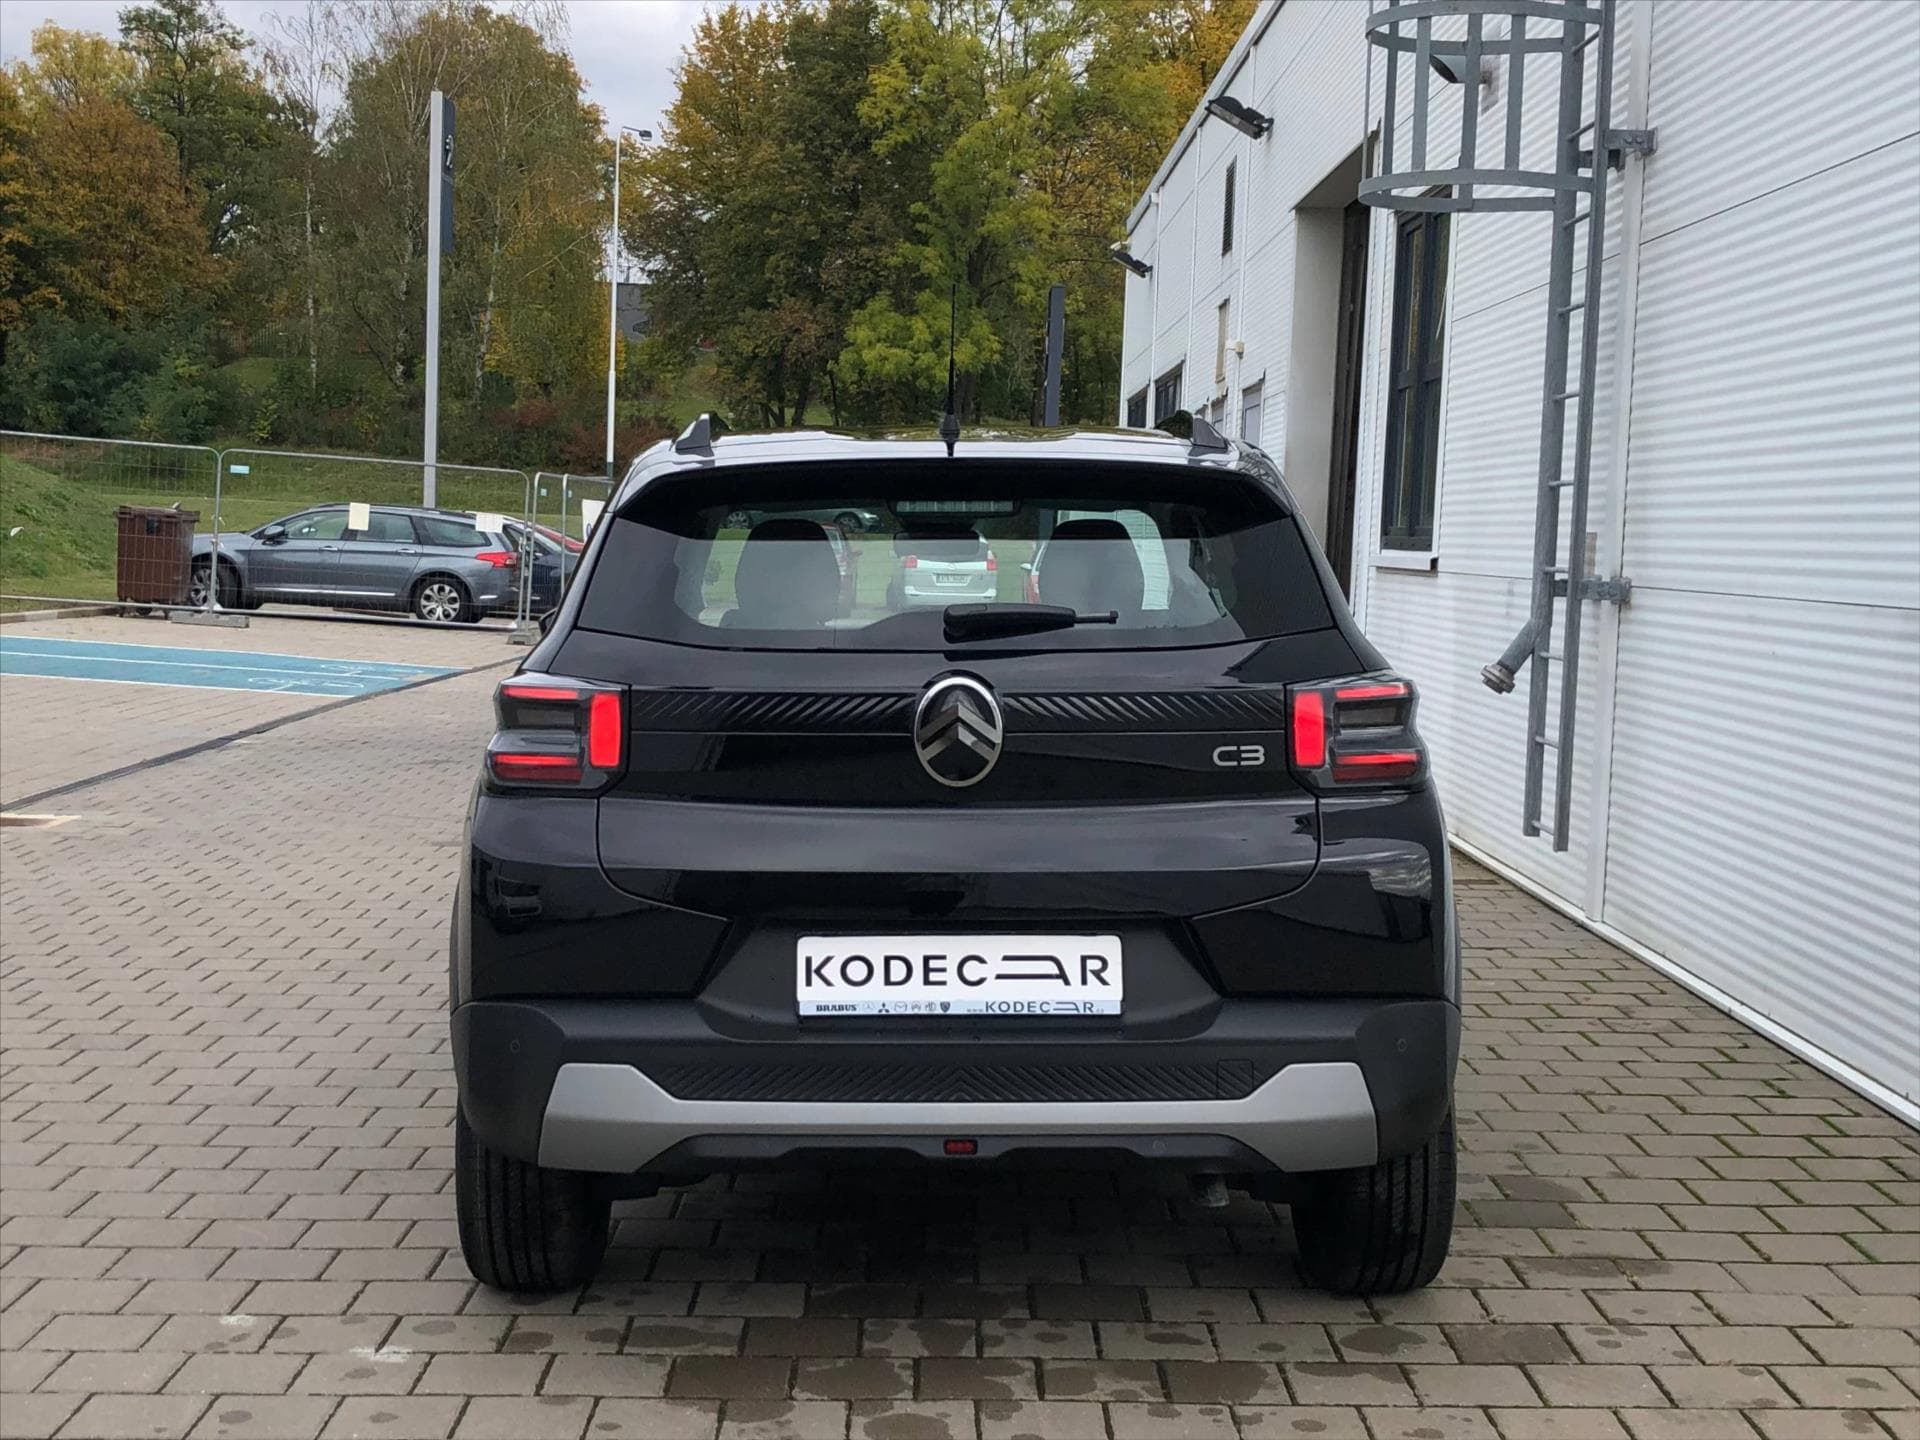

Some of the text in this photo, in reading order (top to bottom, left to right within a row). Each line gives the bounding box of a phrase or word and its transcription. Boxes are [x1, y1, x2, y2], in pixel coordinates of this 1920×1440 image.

[1212, 745, 1265, 767] C3
[804, 954, 1111, 987] KODECAR
[815, 1003, 857, 1012] BRABUS
